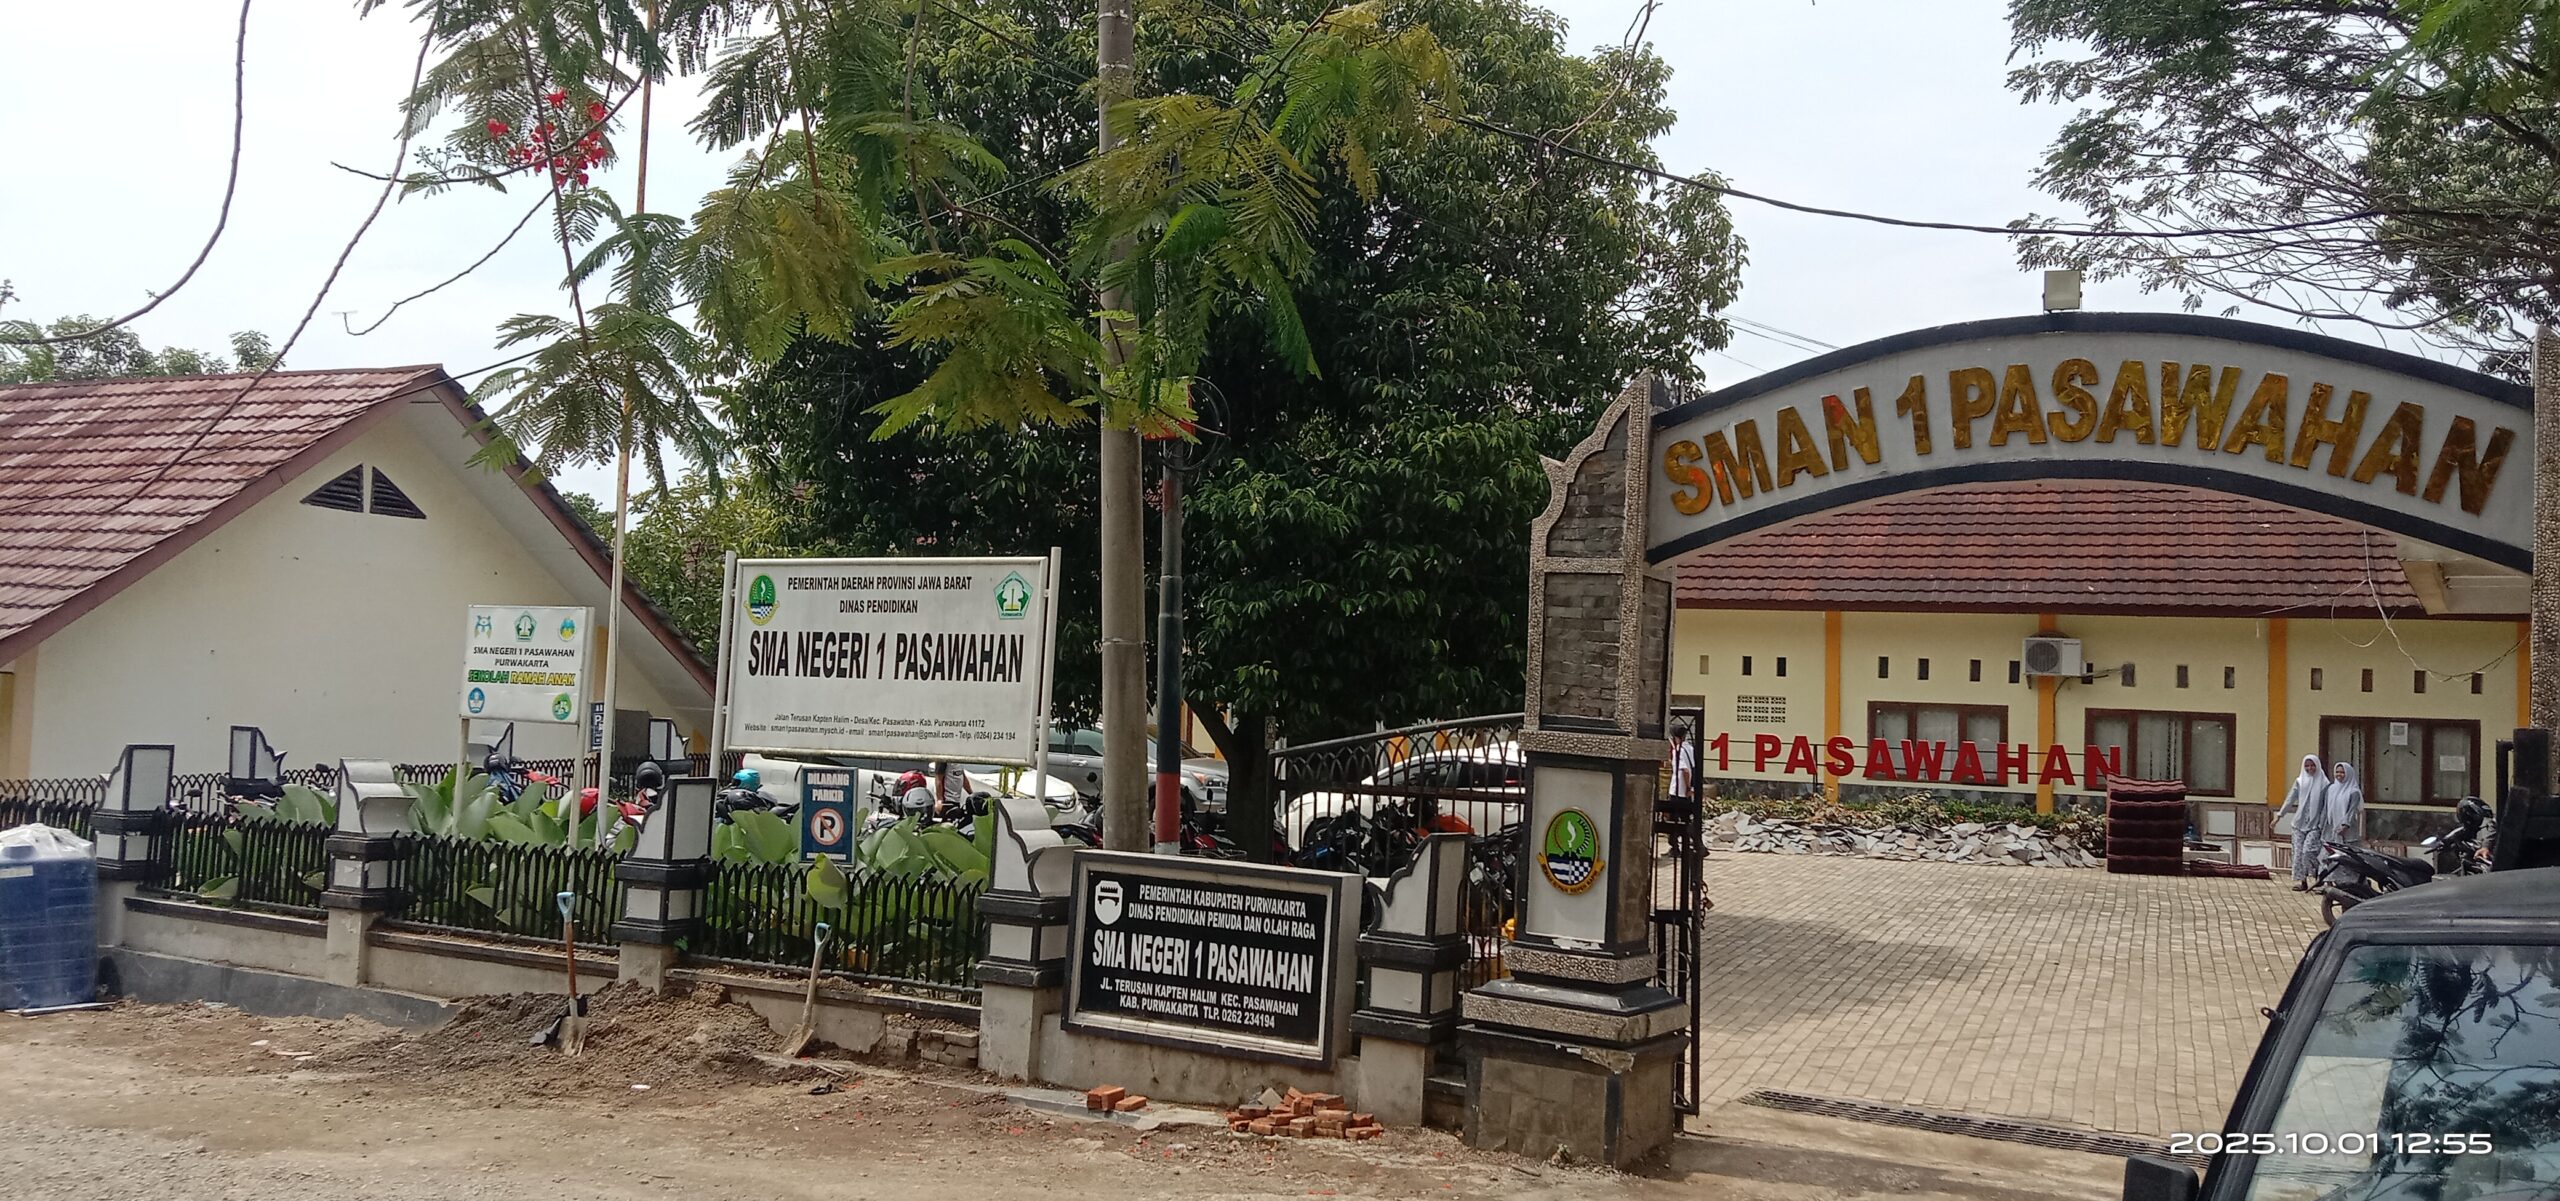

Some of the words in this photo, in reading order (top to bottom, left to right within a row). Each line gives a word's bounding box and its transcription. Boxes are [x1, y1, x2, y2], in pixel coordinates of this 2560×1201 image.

[1664, 386, 1881, 515] SMAN
[1896, 374, 1931, 456] 1
[1949, 358, 2516, 516] PASAWAHAN
[787, 577, 839, 591] PEMERINTAH
[841, 577, 875, 590] DAERAH
[876, 577, 916, 590] PROVINSI
[918, 576, 942, 590] JAWA
[944, 576, 972, 590] BARAT
[839, 600, 865, 613] DINAS
[866, 600, 918, 613] PENDIDIKAN
[473, 646, 488, 655] SMA
[489, 647, 517, 655] NEGERI
[518, 648, 523, 656] 1
[524, 648, 575, 657] PASAWAHAN
[748, 630, 789, 677] SMA
[795, 631, 870, 680] NEGERI
[876, 632, 887, 680] 1
[893, 632, 1024, 683] PASAWAHAN
[494, 659, 549, 668] PURWAKARTA
[510, 671, 546, 685] RAMAH
[546, 672, 576, 686] ANAK
[744, 723, 767, 732] Website
[993, 731, 1004, 740] 234
[1005, 732, 1016, 741] 194
[774, 713, 790, 721] Jalan
[790, 713, 812, 722] Terusan
[812, 714, 833, 724] Kapten
[833, 715, 850, 724] Halim
[882, 717, 915, 726] Pasawahan
[920, 719, 932, 727] Kab.
[934, 719, 967, 727] Purwakarta
[968, 719, 985, 728] 41172
[1710, 732, 1729, 771] 1
[1754, 733, 2121, 791] PASAWAHAN
[807, 773, 850, 787] DILARANG
[819, 815, 836, 838] P
[1139, 884, 1192, 905] PEMERINTAH
[1193, 890, 1244, 911] KABUPATEN
[1245, 895, 1306, 918] PURWAKARTA
[1128, 902, 1154, 920] DINAS
[1155, 905, 1207, 927] PENDIDIKAN
[1207, 911, 1242, 931] PEMUDA
[1244, 915, 1262, 933] DAN
[1291, 920, 1316, 940] RAGA
[1092, 929, 1127, 969] SMA
[1129, 933, 1189, 977] NEGERI
[1194, 940, 1204, 979] 1
[1207, 942, 1314, 994] PASAWAHAN
[1100, 976, 1113, 991] JL.
[1114, 979, 1153, 996] TERUSAN
[1154, 983, 1189, 1001] KAPTEN
[1190, 988, 1217, 1004] HALIM
[1220, 992, 1241, 1008] KEC.
[1243, 995, 1299, 1017] PASAWAHAN
[1120, 994, 1140, 1009] KAB.
[1141, 997, 1199, 1018] PURWAKARTA
[1203, 1005, 1220, 1020] TLP.
[1221, 1008, 1242, 1024] 0262
[1244, 1011, 1275, 1029] 234194
